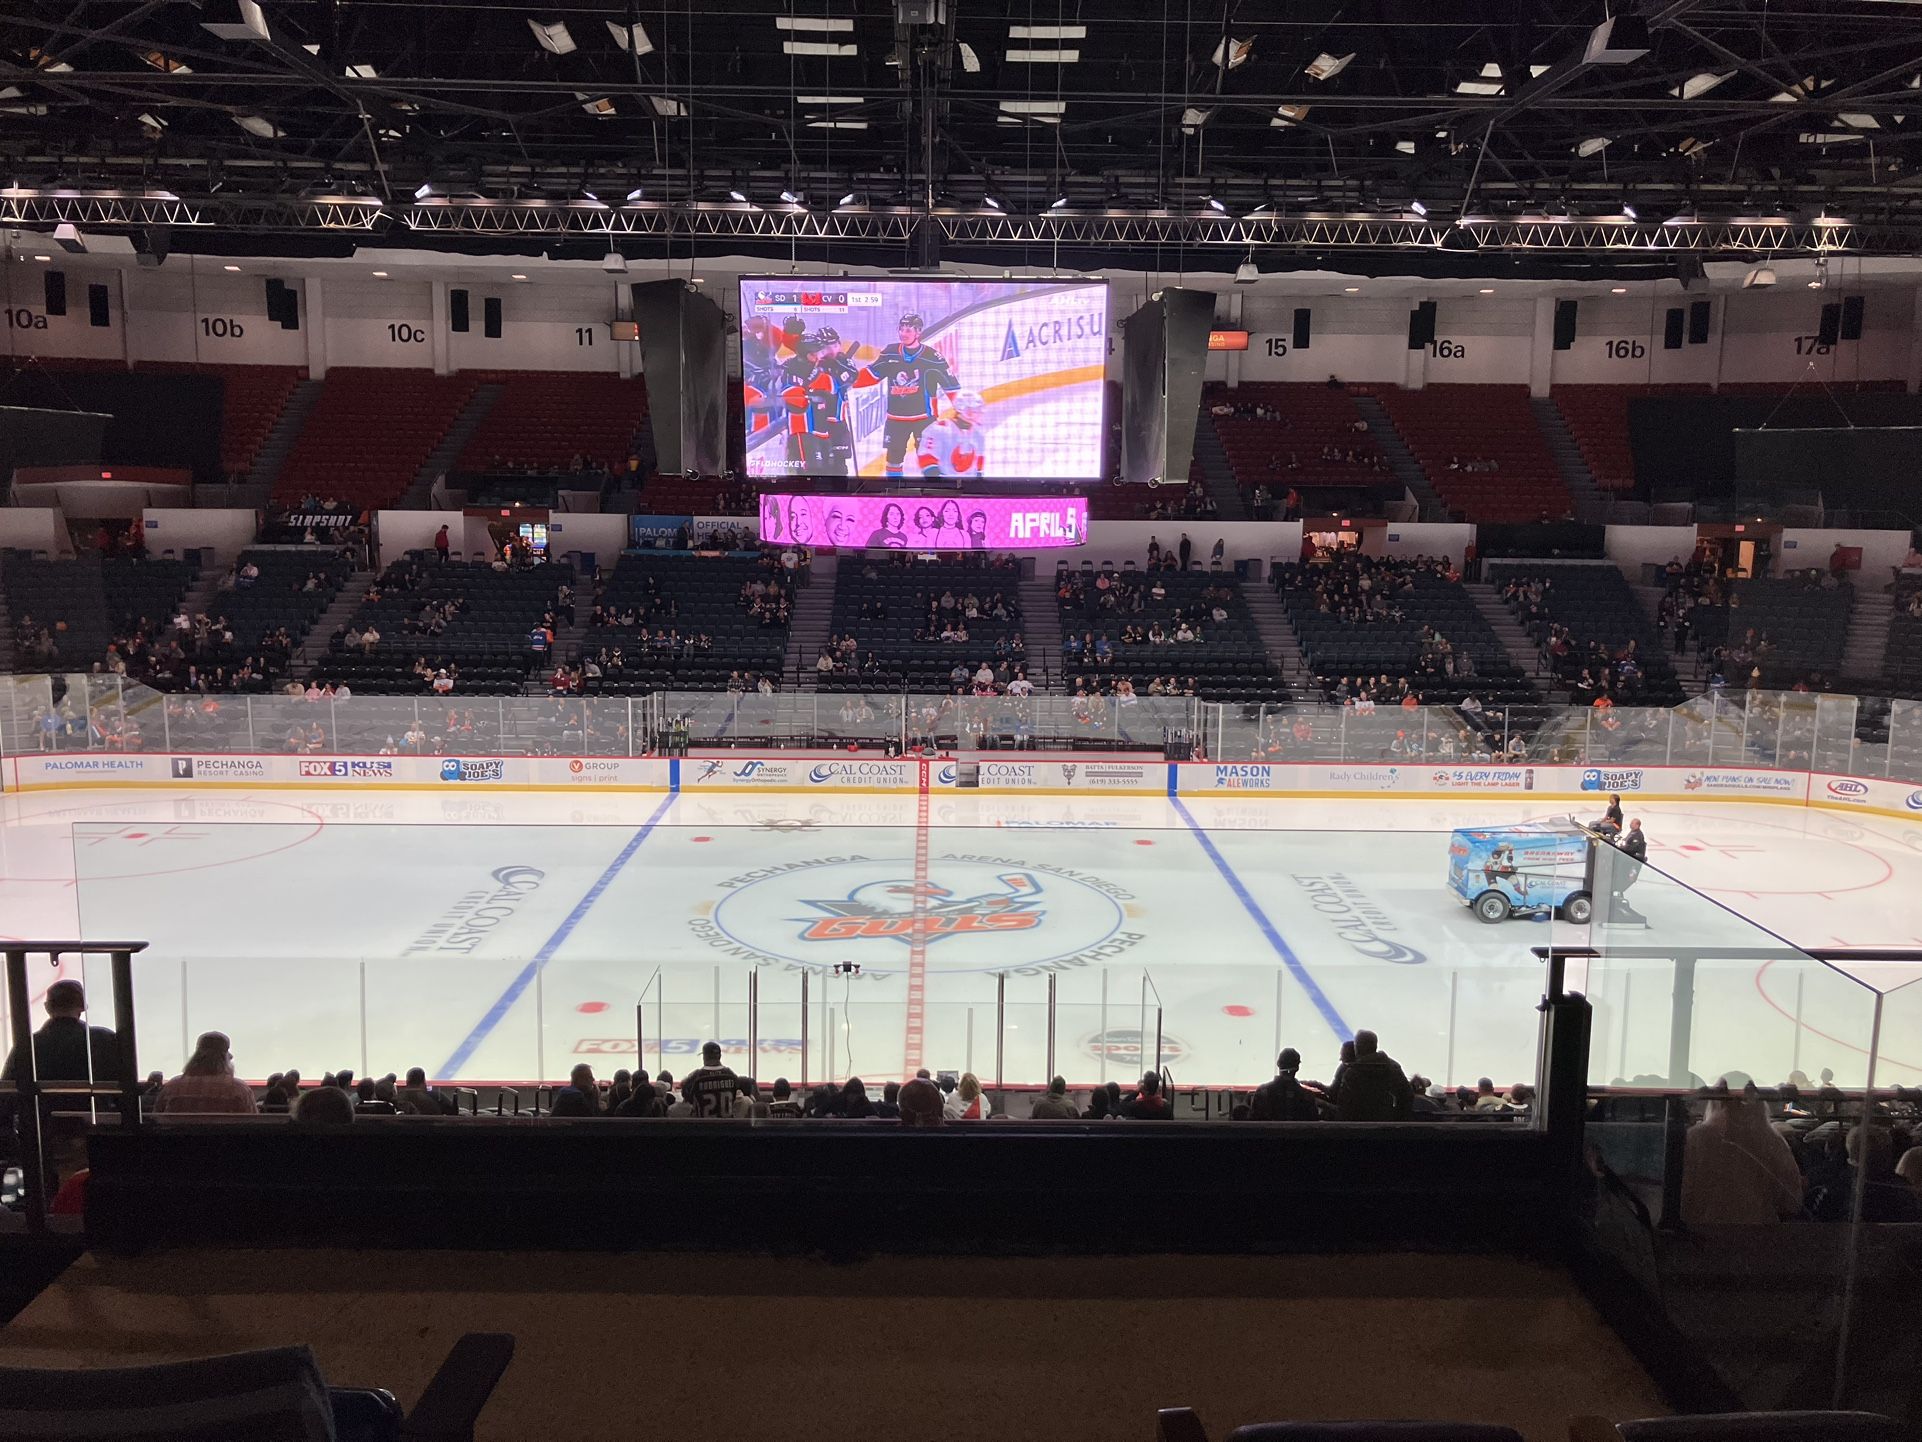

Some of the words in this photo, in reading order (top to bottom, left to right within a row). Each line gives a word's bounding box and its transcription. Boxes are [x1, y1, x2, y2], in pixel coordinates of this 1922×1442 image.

[4, 309, 48, 330] 10a
[201, 317, 244, 338] 10b
[387, 323, 425, 343] 10c
[575, 327, 593, 346] 11
[1265, 338, 1288, 358] 15
[1430, 339, 1465, 359] 16a
[1605, 340, 1645, 359] 16b
[696, 521, 742, 530] OFFICIAL
[1009, 511, 1064, 539] APRIL
[45, 760, 99, 771] PALOMAR
[102, 759, 143, 770] HEALTH
[197, 760, 263, 770] PECHANGA
[300, 762, 332, 776] FOX
[334, 762, 346, 776] 5
[462, 760, 501, 772] SOAPY
[584, 762, 620, 770] GROUP
[828, 762, 857, 776] CAL
[863, 762, 906, 776] COAST
[987, 763, 1035, 777] COAST
[1215, 765, 1271, 777] MASON
[351, 769, 393, 777] NEWS
[467, 768, 500, 779] JOE'S
[598, 774, 618, 783] print
[1329, 771, 1352, 782] Rady
[1493, 771, 1522, 782] FRIDAY
[1602, 771, 1641, 782] SOAPY
[840, 776, 874, 784] CREDIT
[877, 776, 904, 785] UNION
[1606, 779, 1638, 789] JOE'S
[1835, 782, 1862, 793] AHL
[716, 853, 871, 890] PECHANGA
[940, 852, 1026, 866] ARENA
[1032, 863, 1082, 878] SAN
[1080, 875, 1137, 901] DIEGO
[801, 911, 1046, 941] GULLS
[985, 931, 1147, 979] PECHANGA
[702, 1091, 733, 1118] 20
